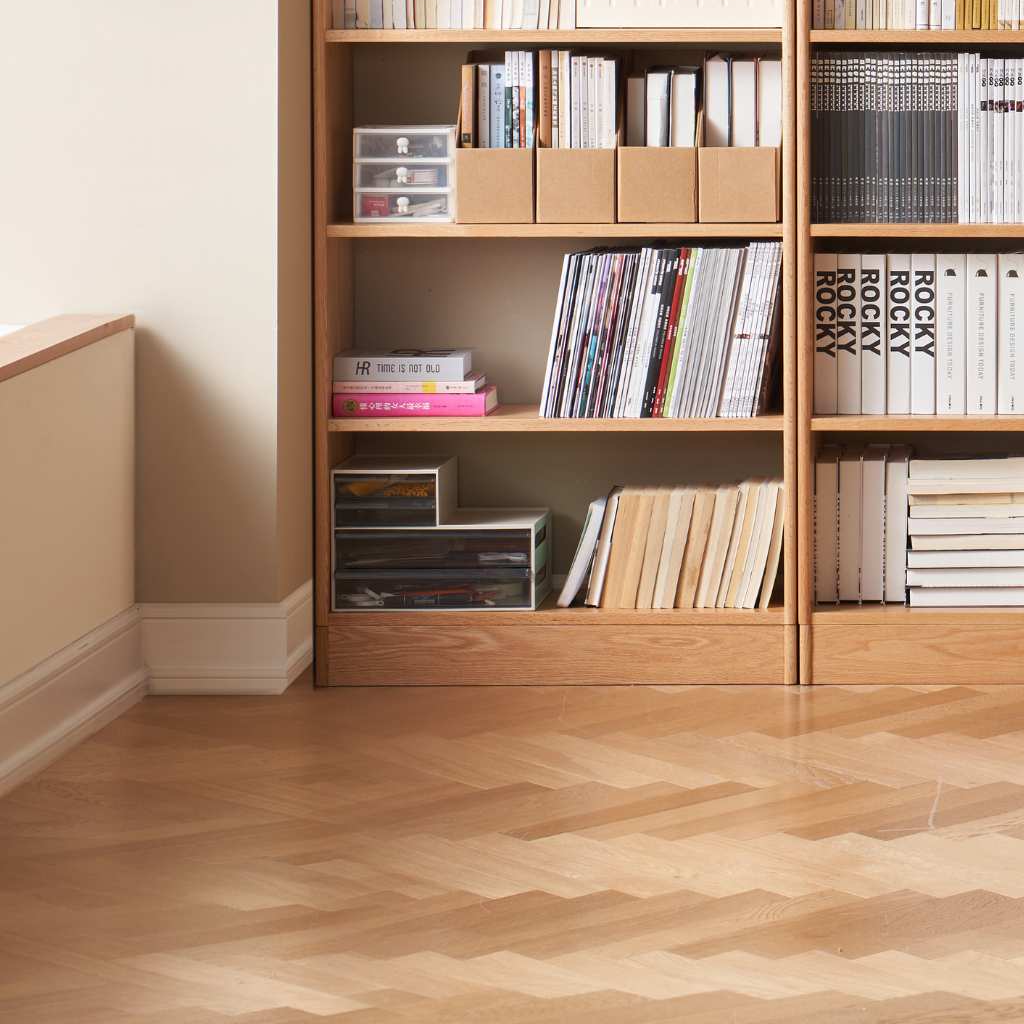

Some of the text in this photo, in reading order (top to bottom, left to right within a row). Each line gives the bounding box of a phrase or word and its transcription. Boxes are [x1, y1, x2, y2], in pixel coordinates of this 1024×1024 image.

[816, 270, 836, 358] ROCKY
[838, 268, 856, 356] ROCKY
[862, 268, 880, 356] ROCKY
[890, 270, 910, 358] ROCKY
[914, 270, 934, 358] ROCKY
[376, 364, 440, 373] TIME IS NOT OLD
